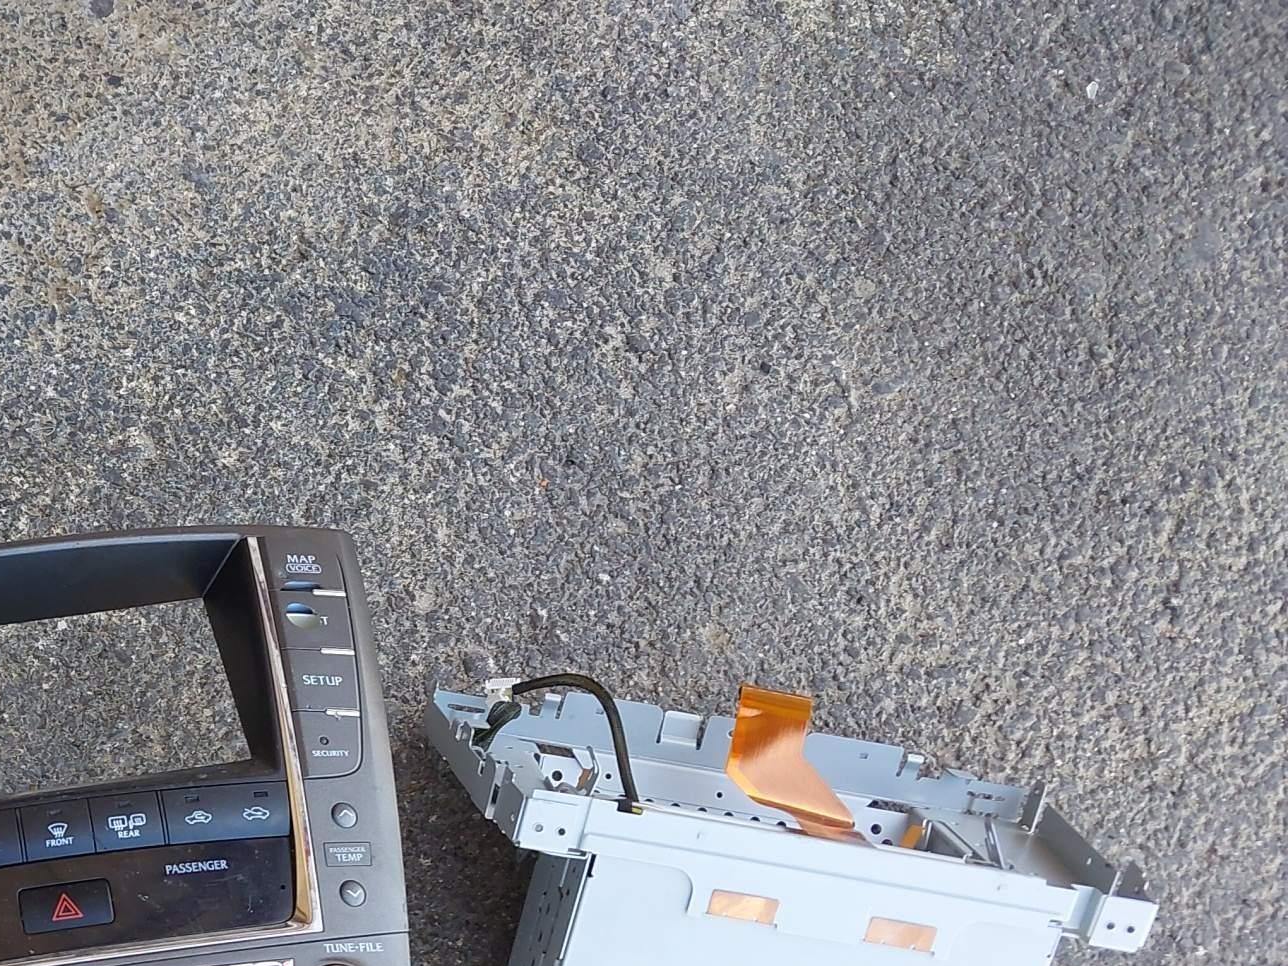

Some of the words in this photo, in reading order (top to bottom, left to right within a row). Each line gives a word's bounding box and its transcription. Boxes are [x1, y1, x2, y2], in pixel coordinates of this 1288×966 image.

[286, 554, 316, 564] MAP
[289, 565, 319, 573] VOICE
[302, 674, 343, 686] SETUP
[311, 749, 350, 757] SECURITY
[117, 829, 140, 839] REAR
[46, 836, 73, 848] FRONT
[329, 846, 367, 854] PASSENGER
[336, 854, 364, 863] TEMP
[165, 859, 229, 875] PASSENGER
